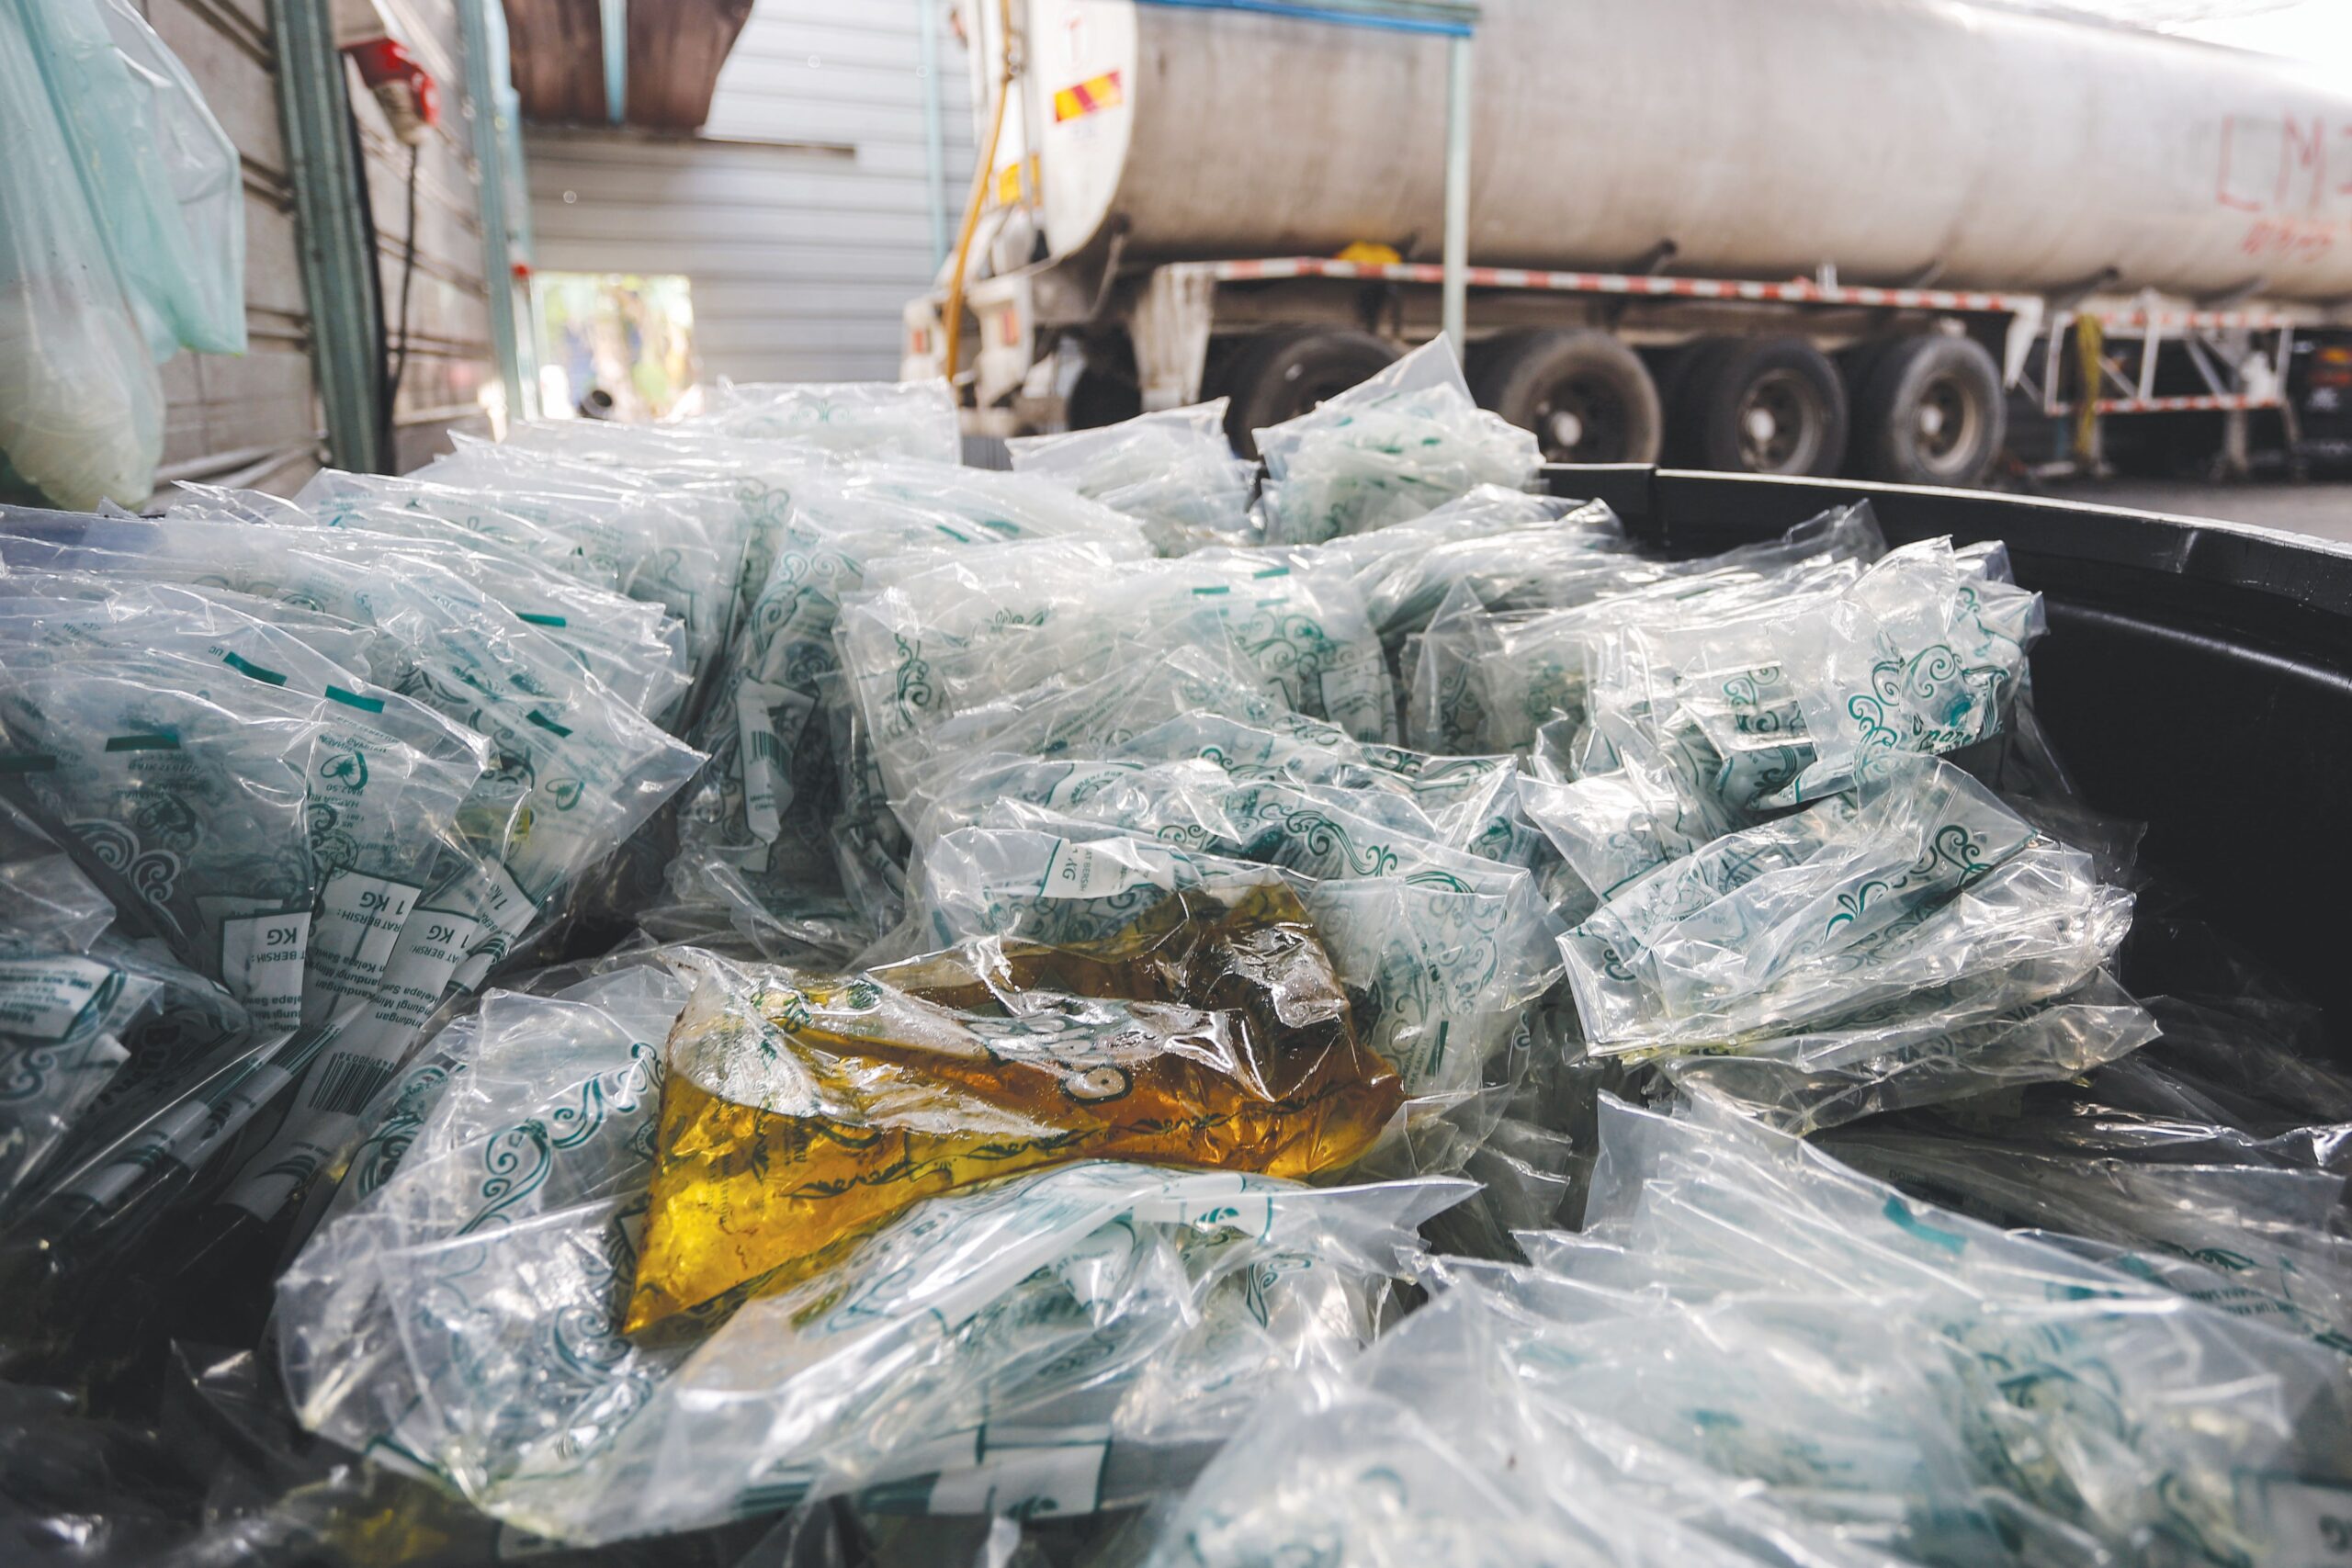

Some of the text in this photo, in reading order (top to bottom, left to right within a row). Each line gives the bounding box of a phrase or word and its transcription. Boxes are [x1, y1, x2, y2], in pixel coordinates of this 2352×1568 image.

[359, 891, 405, 916] 1 KG
[481, 912, 500, 931] BERA
[266, 927, 298, 946] KG
[426, 925, 470, 950] 1 KG
[336, 970, 381, 987] andungi
[375, 1011, 422, 1030] andungan
